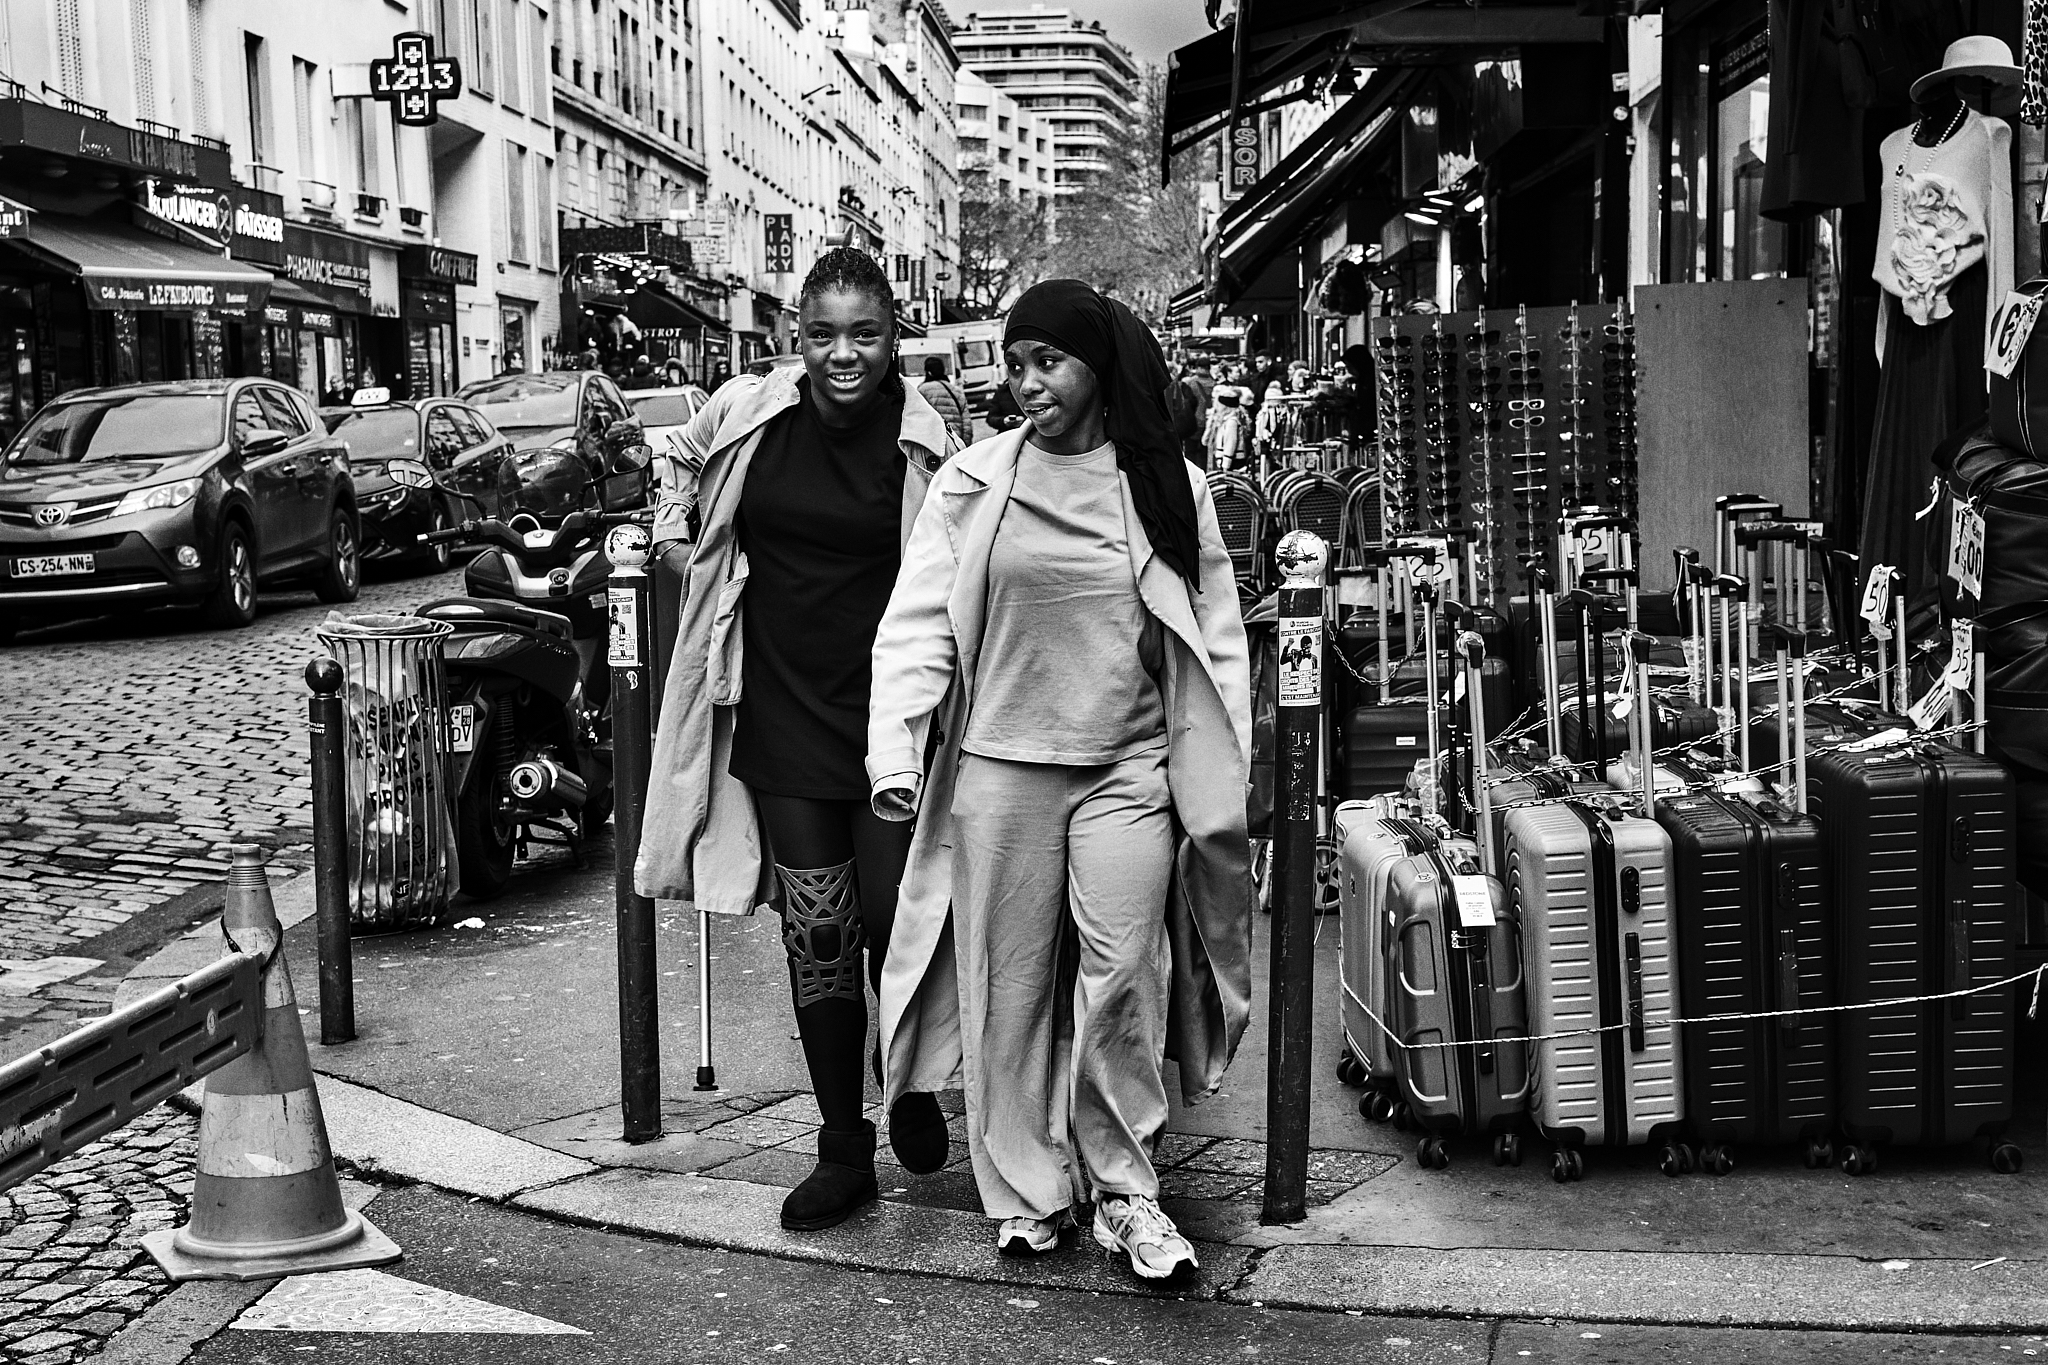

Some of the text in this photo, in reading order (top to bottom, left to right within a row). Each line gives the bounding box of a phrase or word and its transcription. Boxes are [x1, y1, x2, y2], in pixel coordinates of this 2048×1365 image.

[377, 62, 454, 91] 12:13
[766, 216, 778, 271] PINK
[780, 216, 792, 271] LADY
[286, 254, 333, 285] PHARMACIE
[640, 327, 682, 338] ISTROT
[1865, 580, 1888, 616] 50
[462, 717, 471, 726] 28
